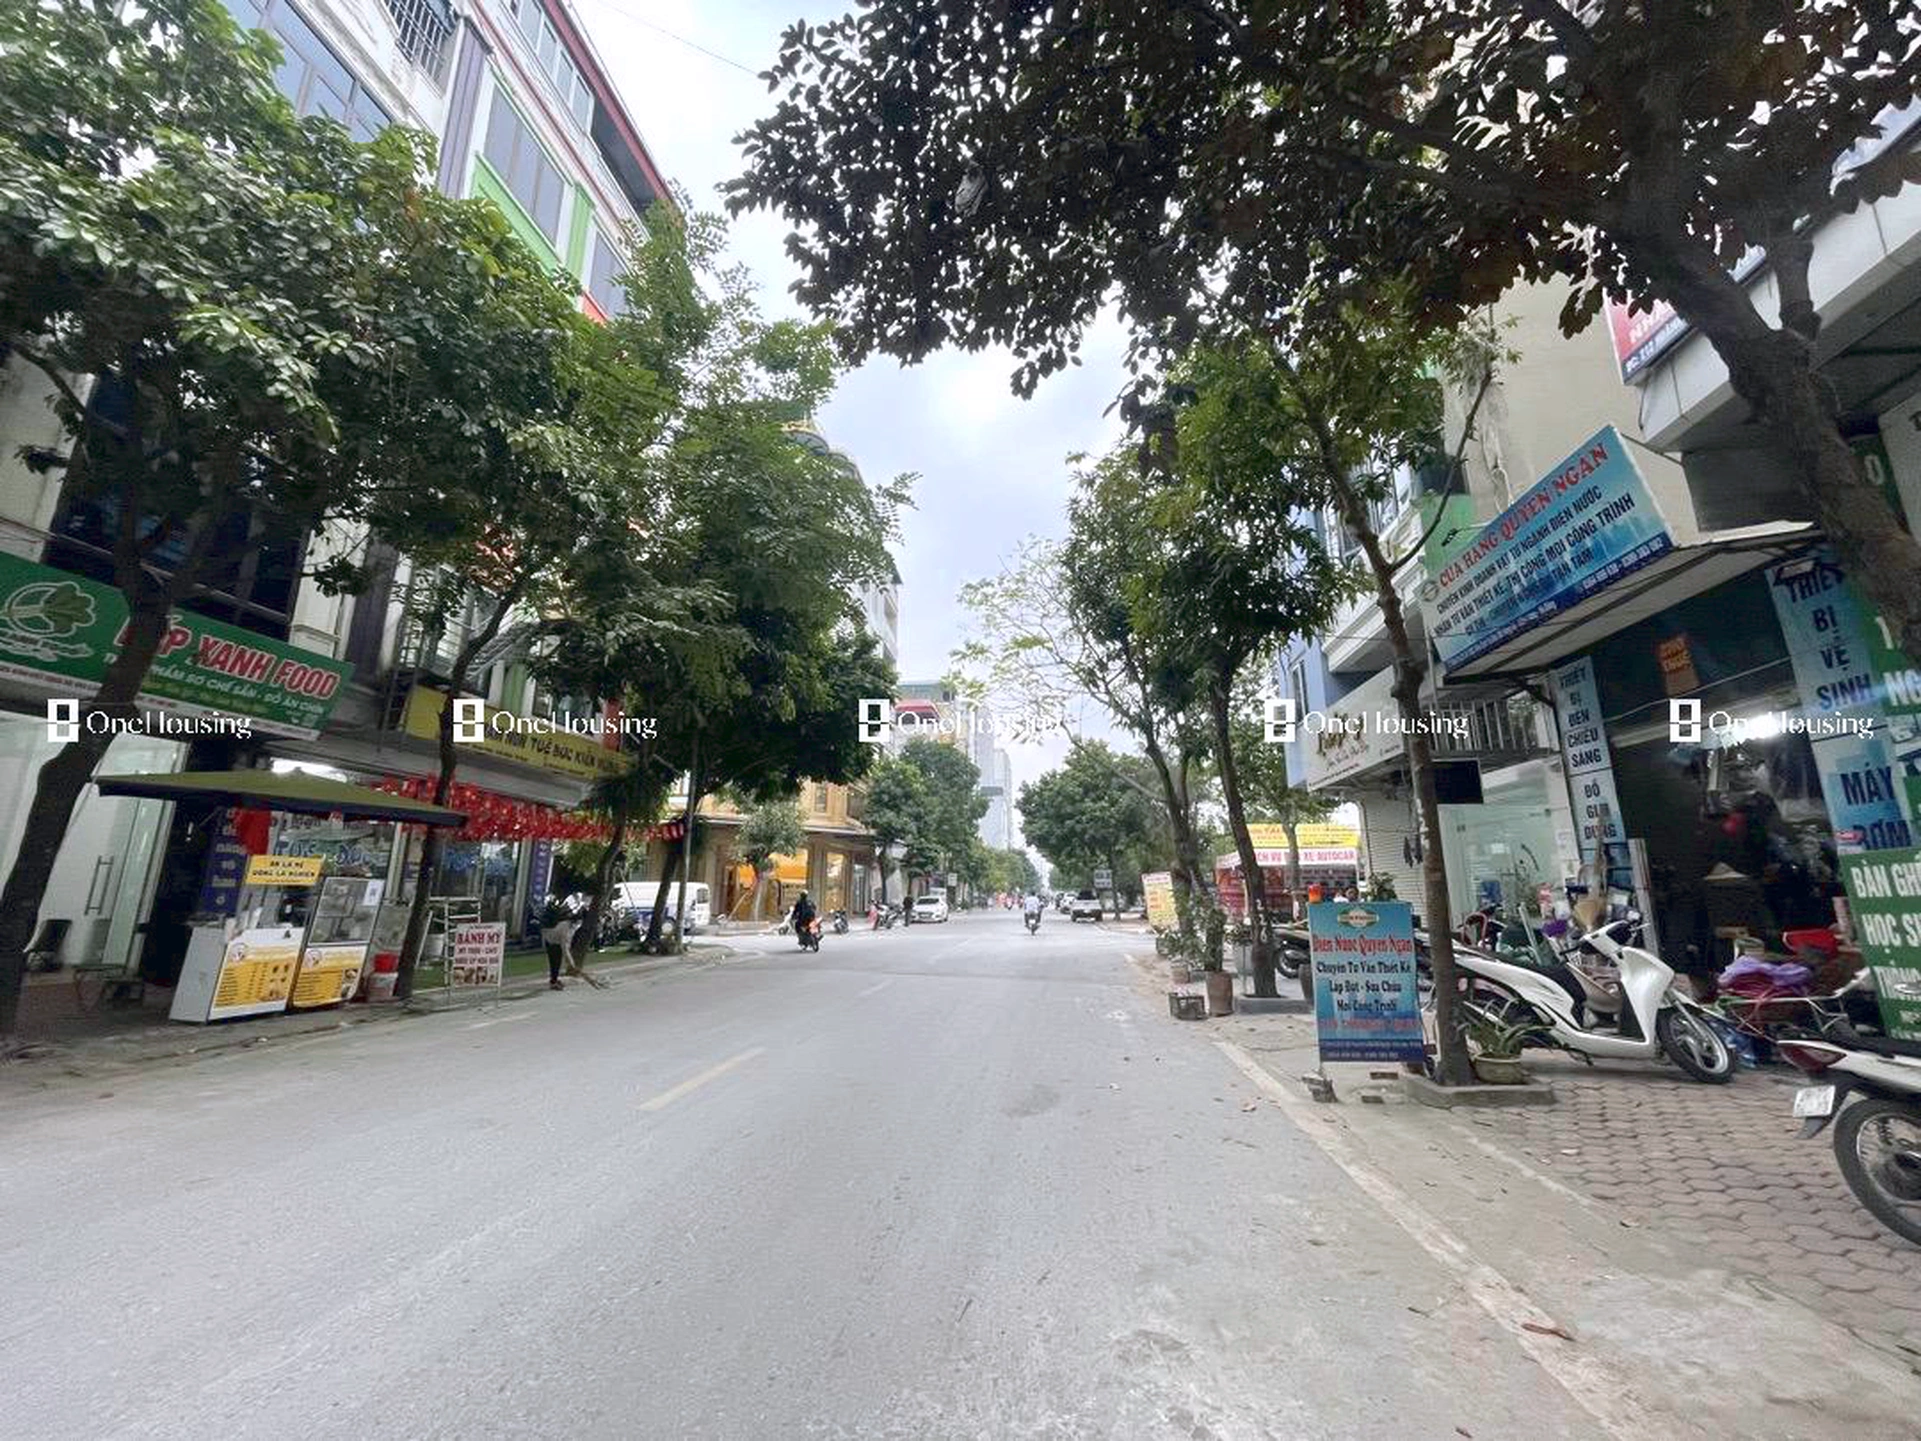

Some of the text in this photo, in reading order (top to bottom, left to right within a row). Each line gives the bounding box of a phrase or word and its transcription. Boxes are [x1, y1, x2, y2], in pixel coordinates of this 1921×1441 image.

[199, 636, 277, 683] XANH
[273, 659, 340, 699] FOOD
[1816, 673, 1873, 711] SINH
[1841, 763, 1895, 806] MÁY
[1850, 859, 1893, 898] BÀN
[1861, 913, 1902, 954] HỌC
